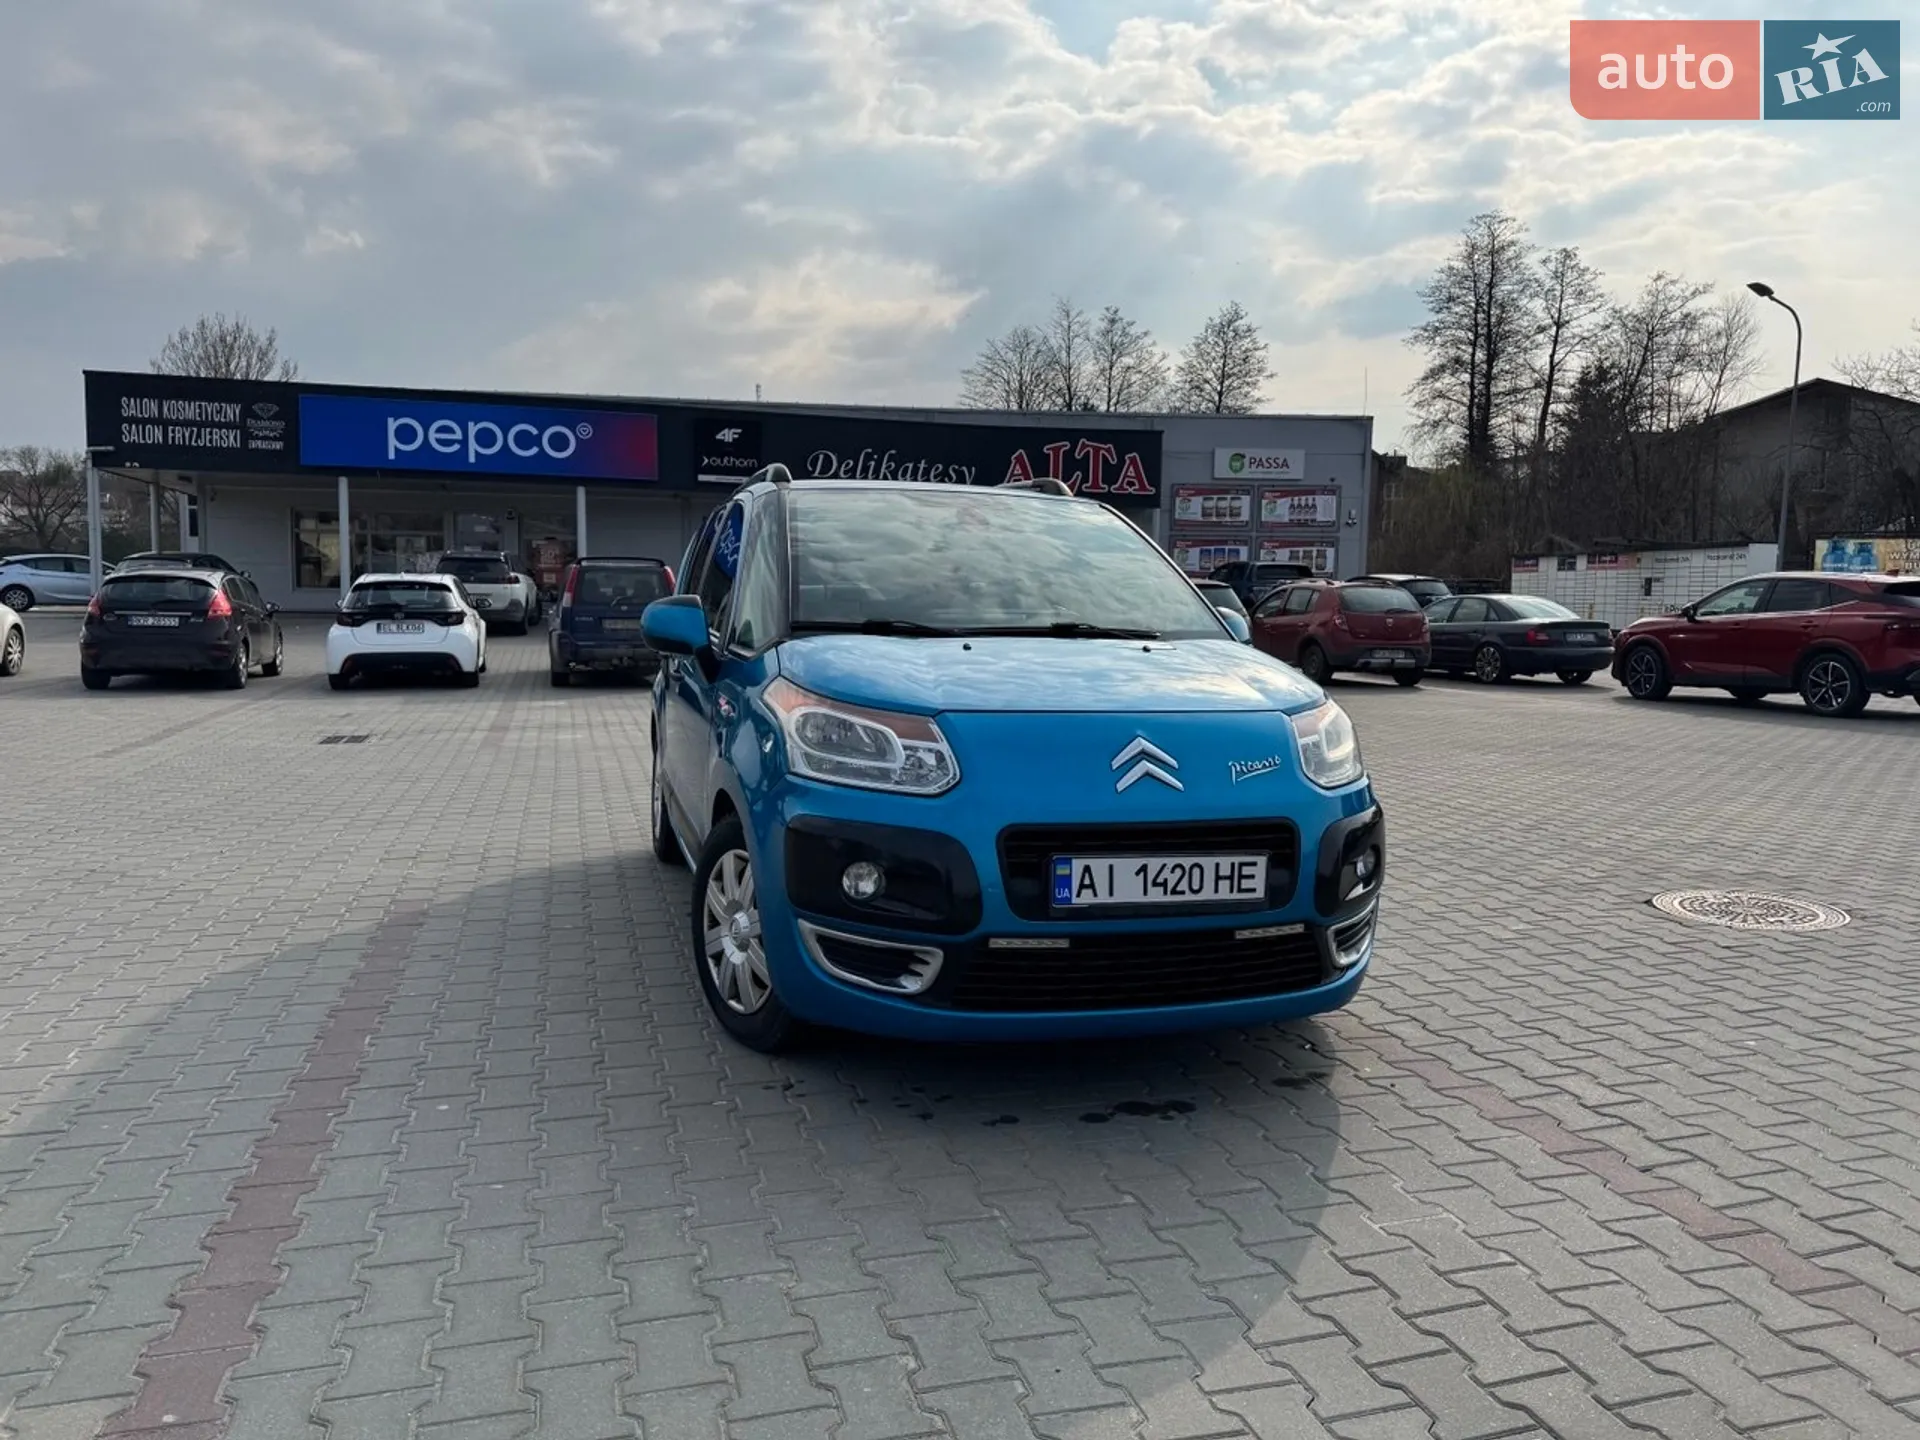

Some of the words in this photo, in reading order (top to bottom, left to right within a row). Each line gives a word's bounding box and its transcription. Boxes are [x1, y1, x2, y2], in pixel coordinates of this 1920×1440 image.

[121, 396, 159, 419] SALON
[162, 399, 242, 424] KOSMETYCZNY
[121, 423, 163, 445] SALON
[167, 425, 241, 449] FRYZJERSKI
[387, 416, 577, 464] pepco
[715, 427, 743, 443] 4F
[709, 454, 759, 469] outhorn
[806, 448, 976, 485] Delikatesy
[1003, 437, 1157, 496] ALTA
[1248, 456, 1290, 470] PASSA
[1055, 888, 1071, 898] UA
[1075, 863, 1115, 899] AI
[1134, 861, 1205, 897] 1420
[1213, 860, 1259, 895] HE
